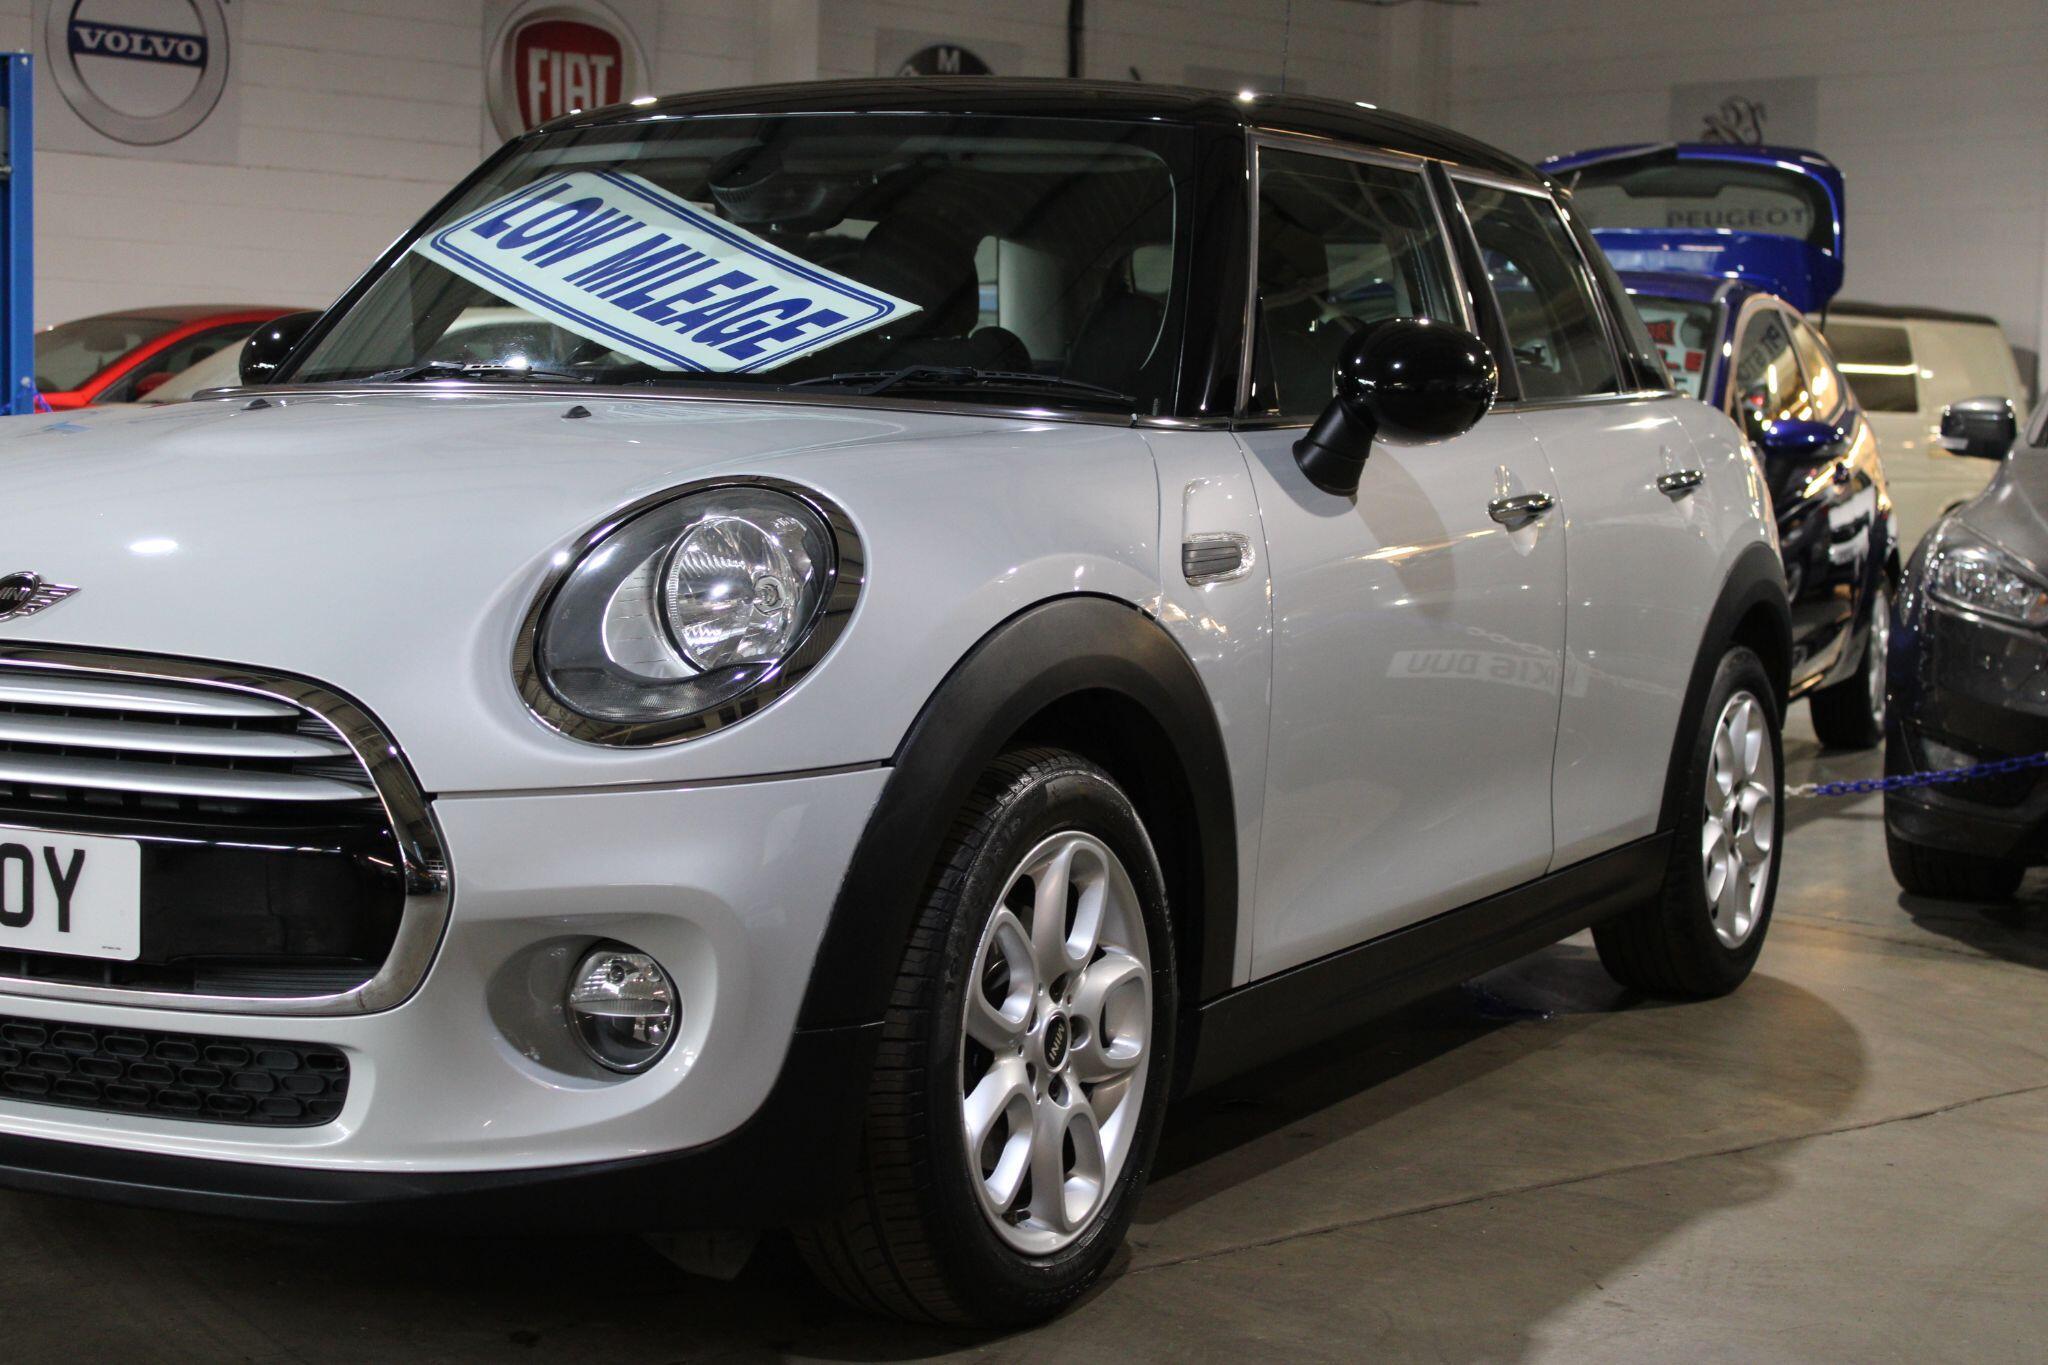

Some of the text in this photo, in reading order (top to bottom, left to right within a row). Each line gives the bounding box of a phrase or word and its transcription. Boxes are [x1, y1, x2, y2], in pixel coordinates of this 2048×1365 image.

[74, 27, 200, 61] VOLVO
[527, 47, 614, 126] FIAT
[1666, 207, 1806, 228] PEUGEOT
[470, 182, 849, 361] LOW MILEAGE
[0, 842, 86, 933] OY
[1048, 1023, 1065, 1061] MINI
